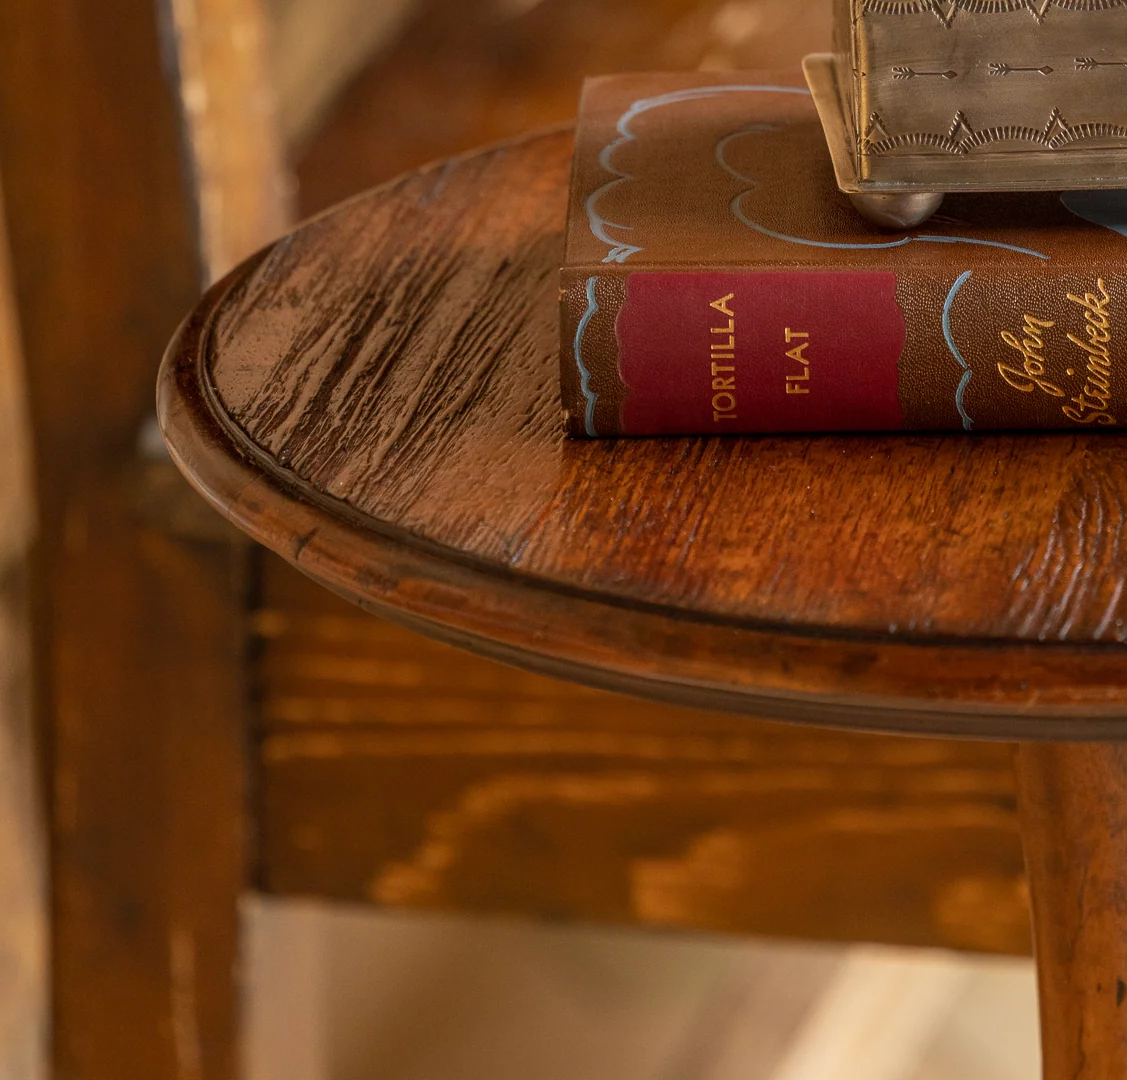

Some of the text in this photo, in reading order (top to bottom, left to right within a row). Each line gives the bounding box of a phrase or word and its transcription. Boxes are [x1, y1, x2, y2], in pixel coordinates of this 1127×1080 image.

[709, 292, 738, 422] TORTILLA
[784, 327, 810, 394] FLAT
[997, 313, 1066, 397] John
[1061, 278, 1117, 425] Steinbeck
